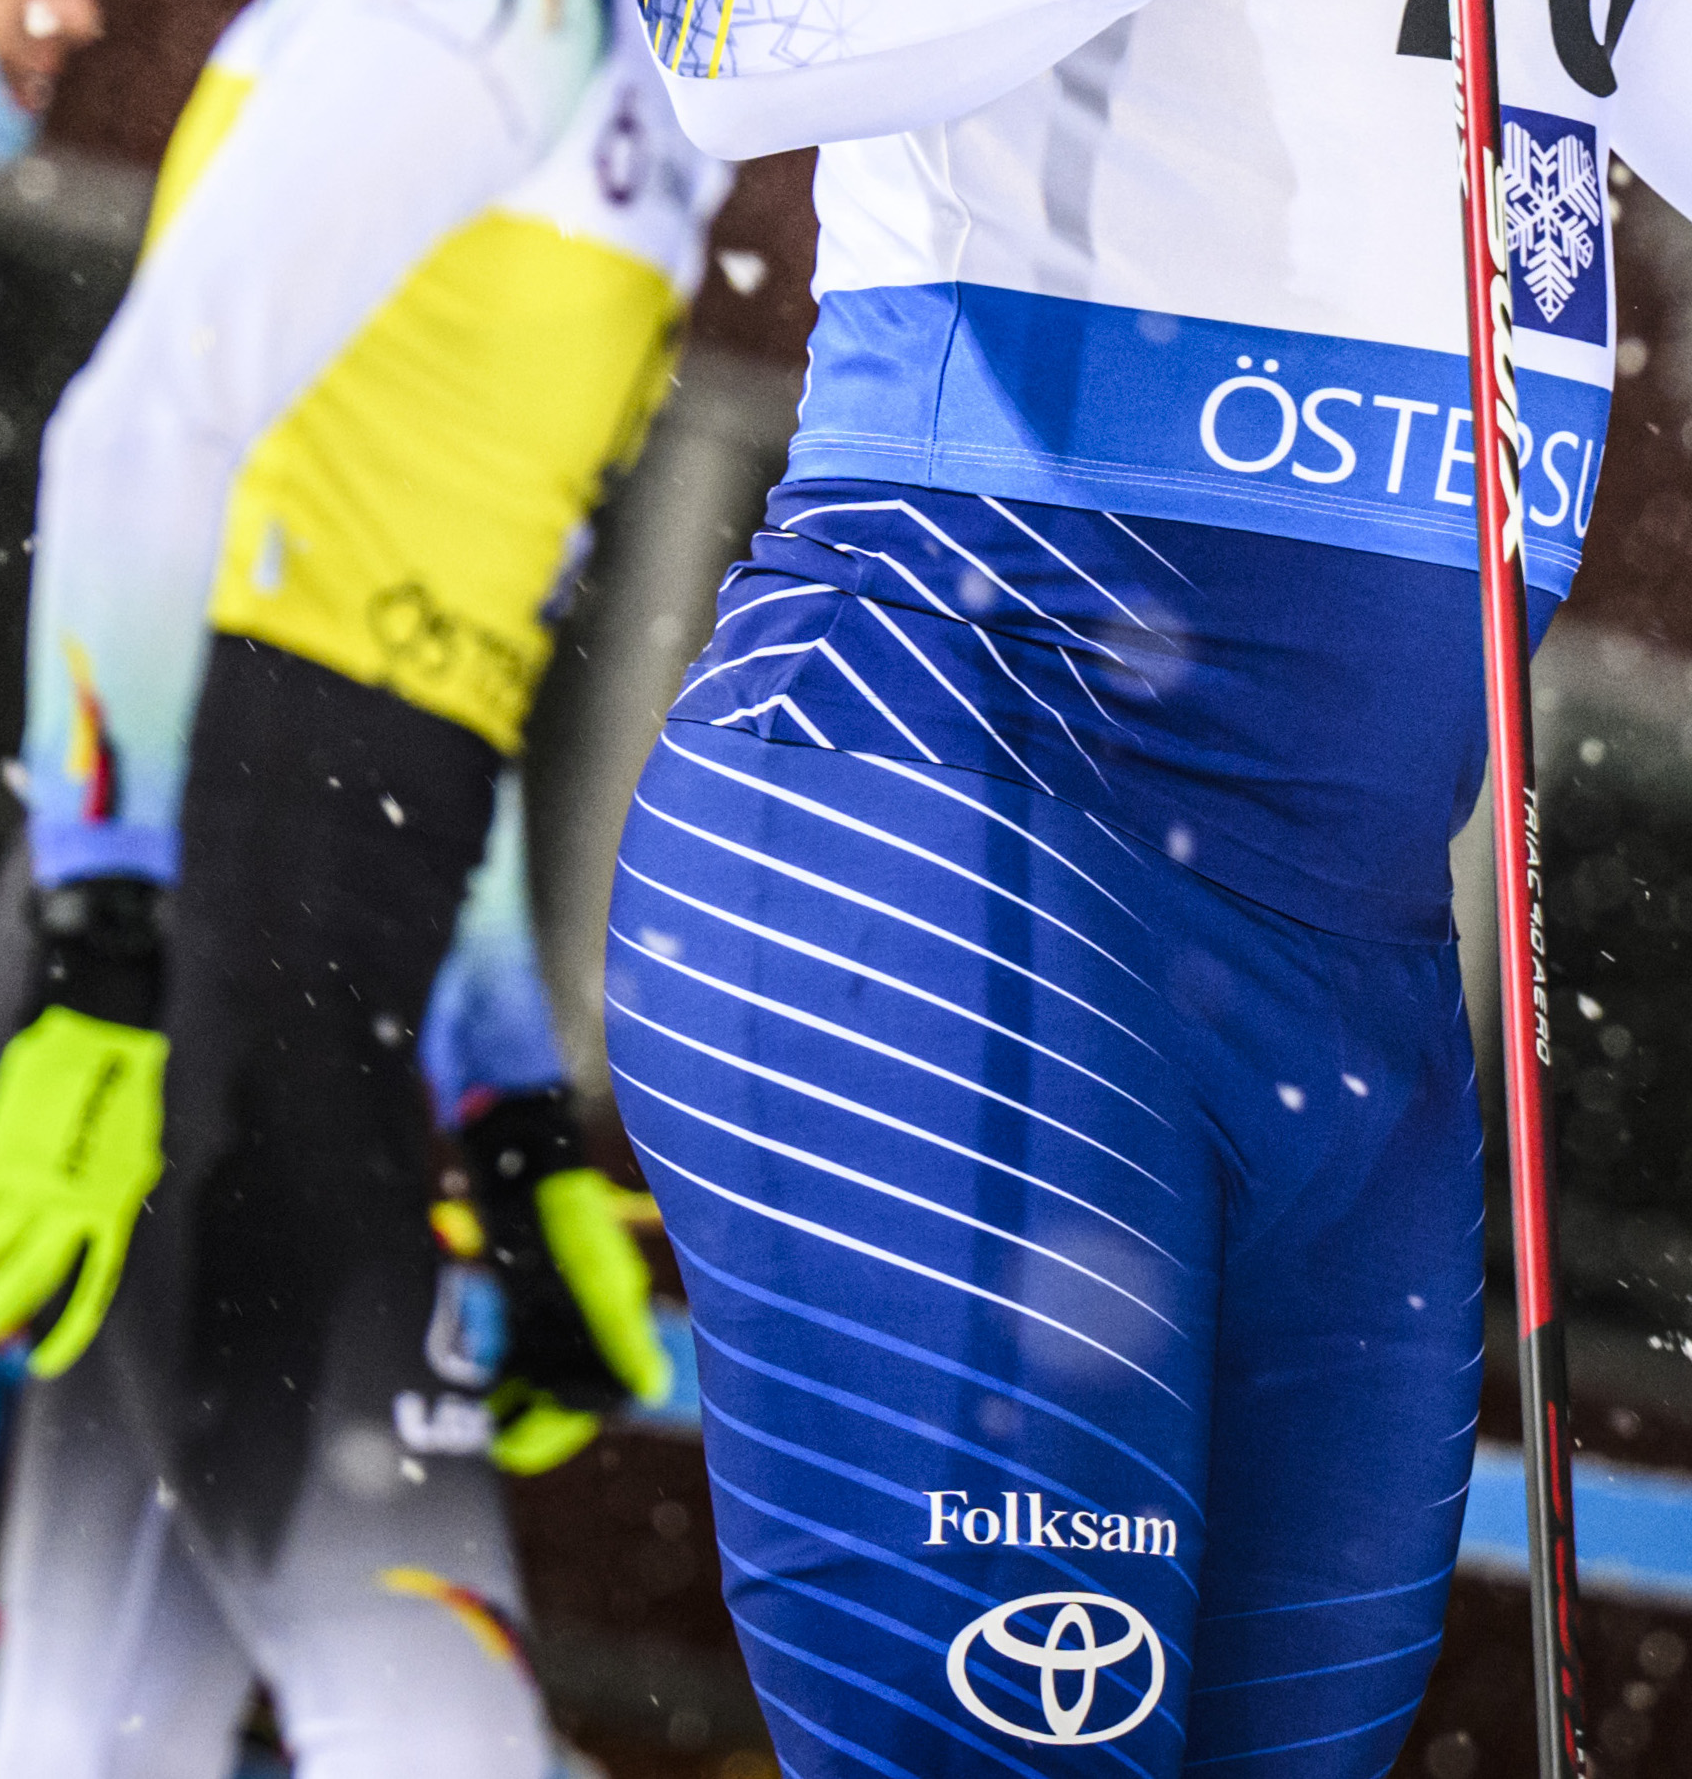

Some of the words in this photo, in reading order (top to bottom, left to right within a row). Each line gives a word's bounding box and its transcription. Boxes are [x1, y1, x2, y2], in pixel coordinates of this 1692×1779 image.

[1522, 786, 1544, 899] TRIAC
[1532, 955, 1551, 1067] AERO
[922, 1489, 1178, 1558] Folksam
